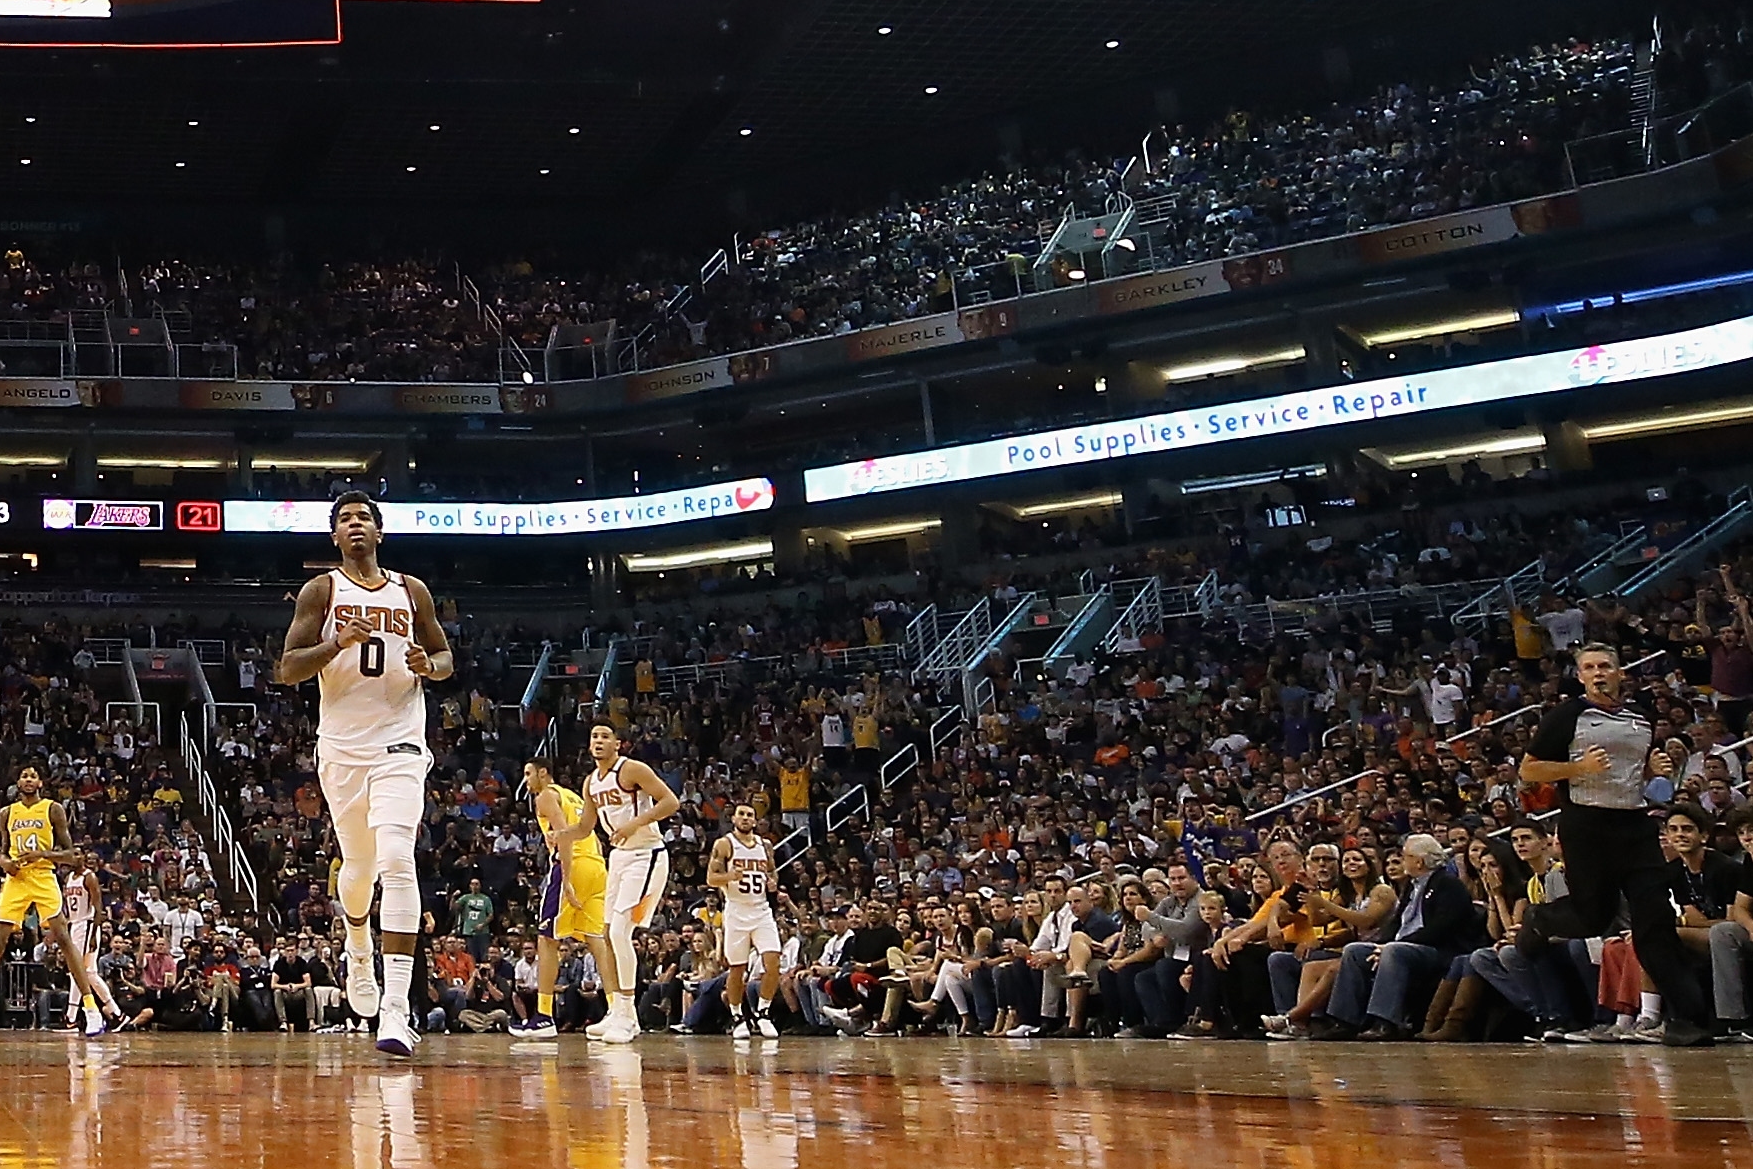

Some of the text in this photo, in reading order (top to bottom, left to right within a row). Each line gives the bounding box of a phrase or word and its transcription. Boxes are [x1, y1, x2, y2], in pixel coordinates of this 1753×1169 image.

[1385, 222, 1485, 253] COTTON
[1113, 275, 1209, 304] BARKLEY
[859, 325, 947, 352] MAJERLE
[211, 390, 262, 402] DAVIS
[403, 393, 492, 406] CHAMBERS
[1007, 383, 1429, 465] Pool Supplies Service Repair
[85, 502, 150, 528] LAKERS
[188, 507, 213, 526] 21
[415, 493, 734, 535] Pool Supplies Service Repa
[358, 636, 386, 678] 0
[592, 788, 622, 807] UNS
[16, 832, 38, 854] 14
[737, 871, 764, 895] 55
